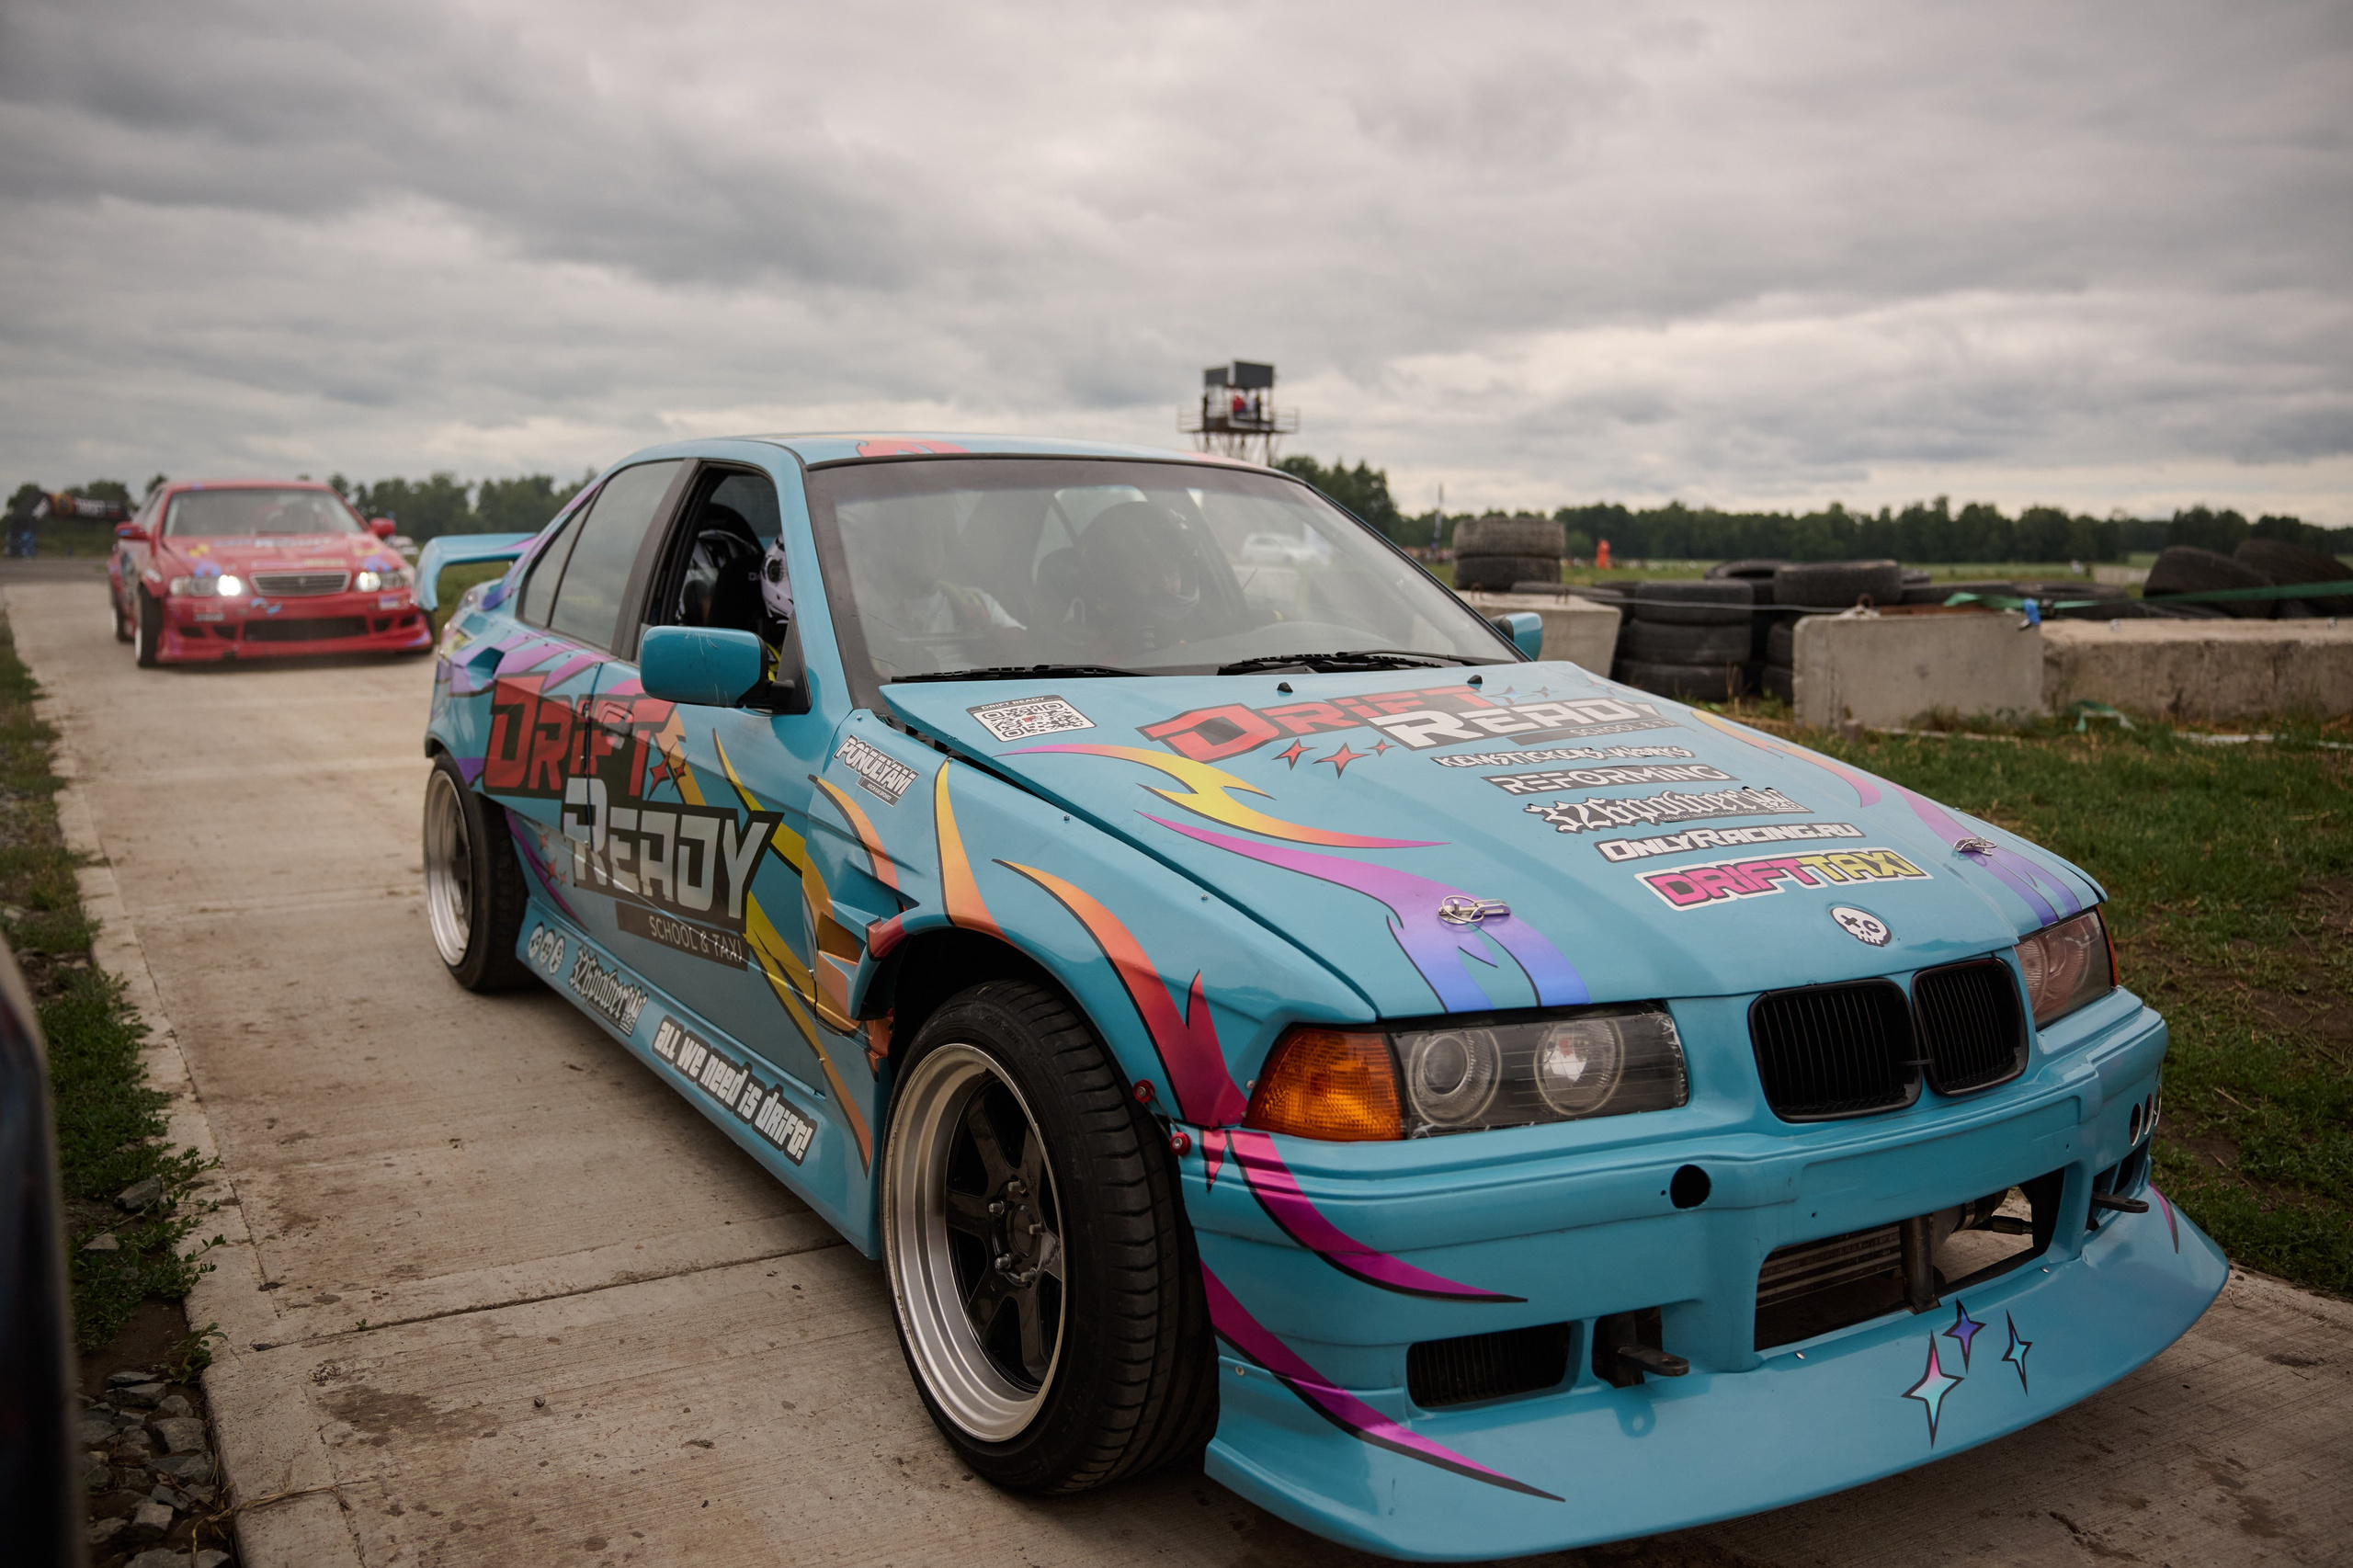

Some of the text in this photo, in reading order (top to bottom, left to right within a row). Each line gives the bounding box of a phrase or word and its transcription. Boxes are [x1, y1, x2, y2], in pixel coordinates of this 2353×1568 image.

[981, 697, 1044, 710] DRIFT READY
[1570, 723, 1643, 736] SCHOOL
[835, 736, 917, 795] PONULYAM
[563, 778, 770, 919] READY
[1599, 824, 1862, 861] ONLYRACING.RU
[649, 915, 742, 963] SCHOOL & TAXI
[984, 1016, 1023, 1046] OUTSIDE
